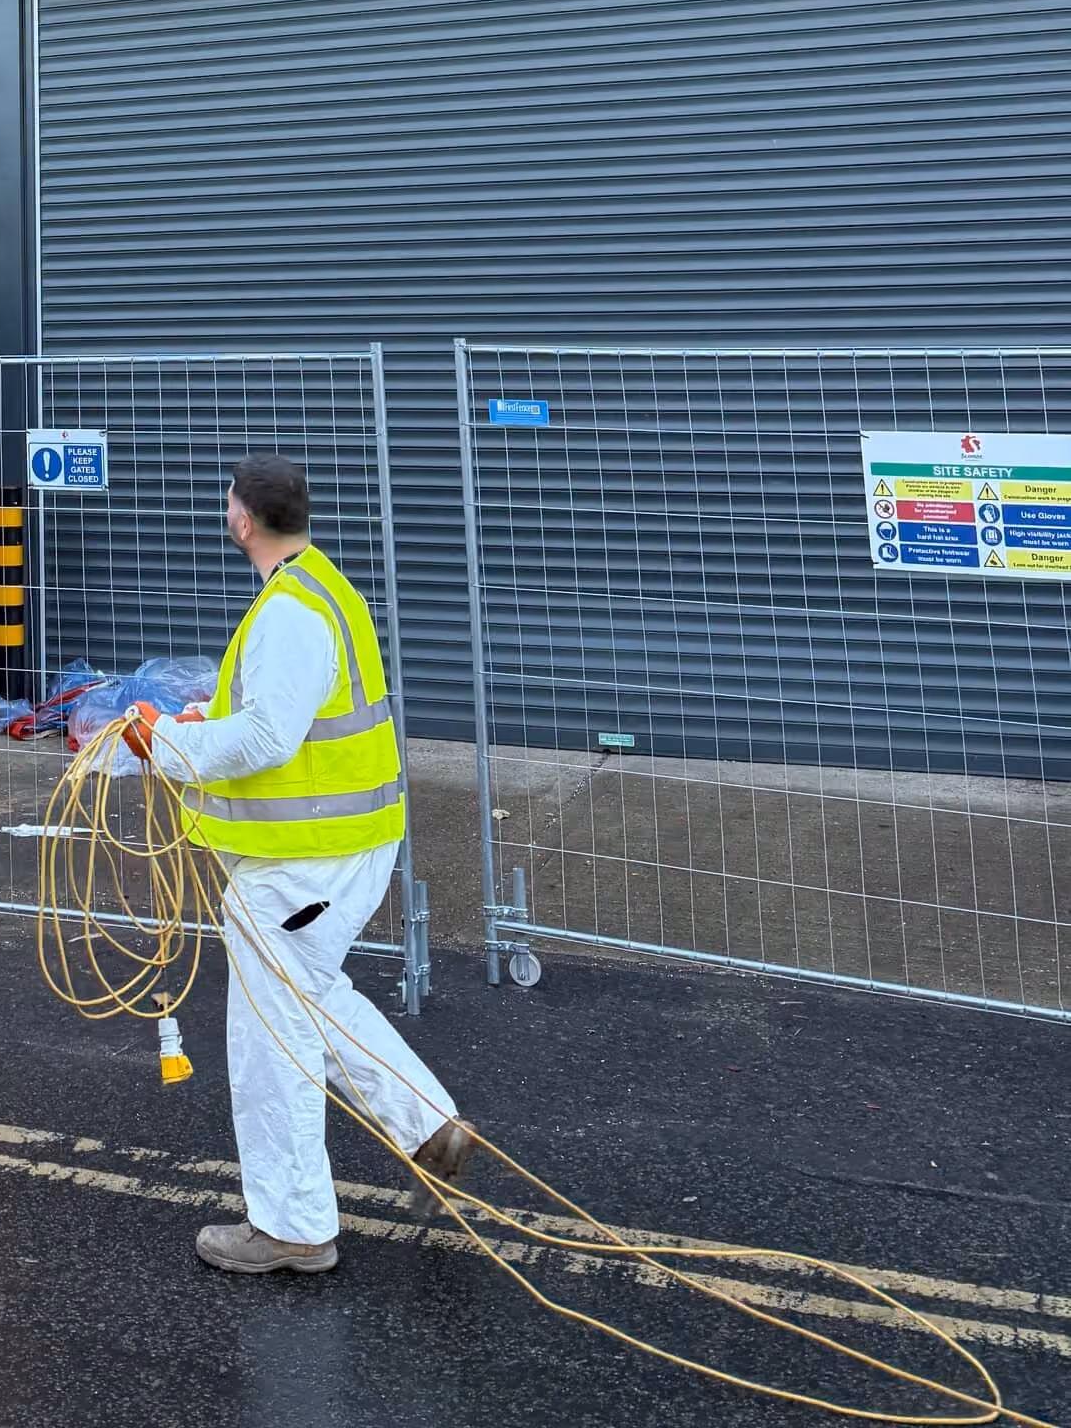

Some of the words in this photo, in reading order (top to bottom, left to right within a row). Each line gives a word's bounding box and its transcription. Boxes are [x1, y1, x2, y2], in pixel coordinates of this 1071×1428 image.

[68, 448, 98, 456] PLEASE
[72, 457, 93, 465] KEEP
[70, 466, 96, 474] GATES
[932, 465, 962, 477] SITE
[963, 466, 1013, 478] SAFETY
[68, 475, 99, 483] CLOSED
[1024, 484, 1057, 495] Danger
[1020, 510, 1037, 520] Use
[1037, 511, 1066, 521] Gloves
[922, 525, 938, 533] This
[1009, 529, 1026, 538] High
[1026, 531, 1055, 540] visibility
[908, 547, 941, 555] Protective
[1031, 552, 1064, 563] Danger
